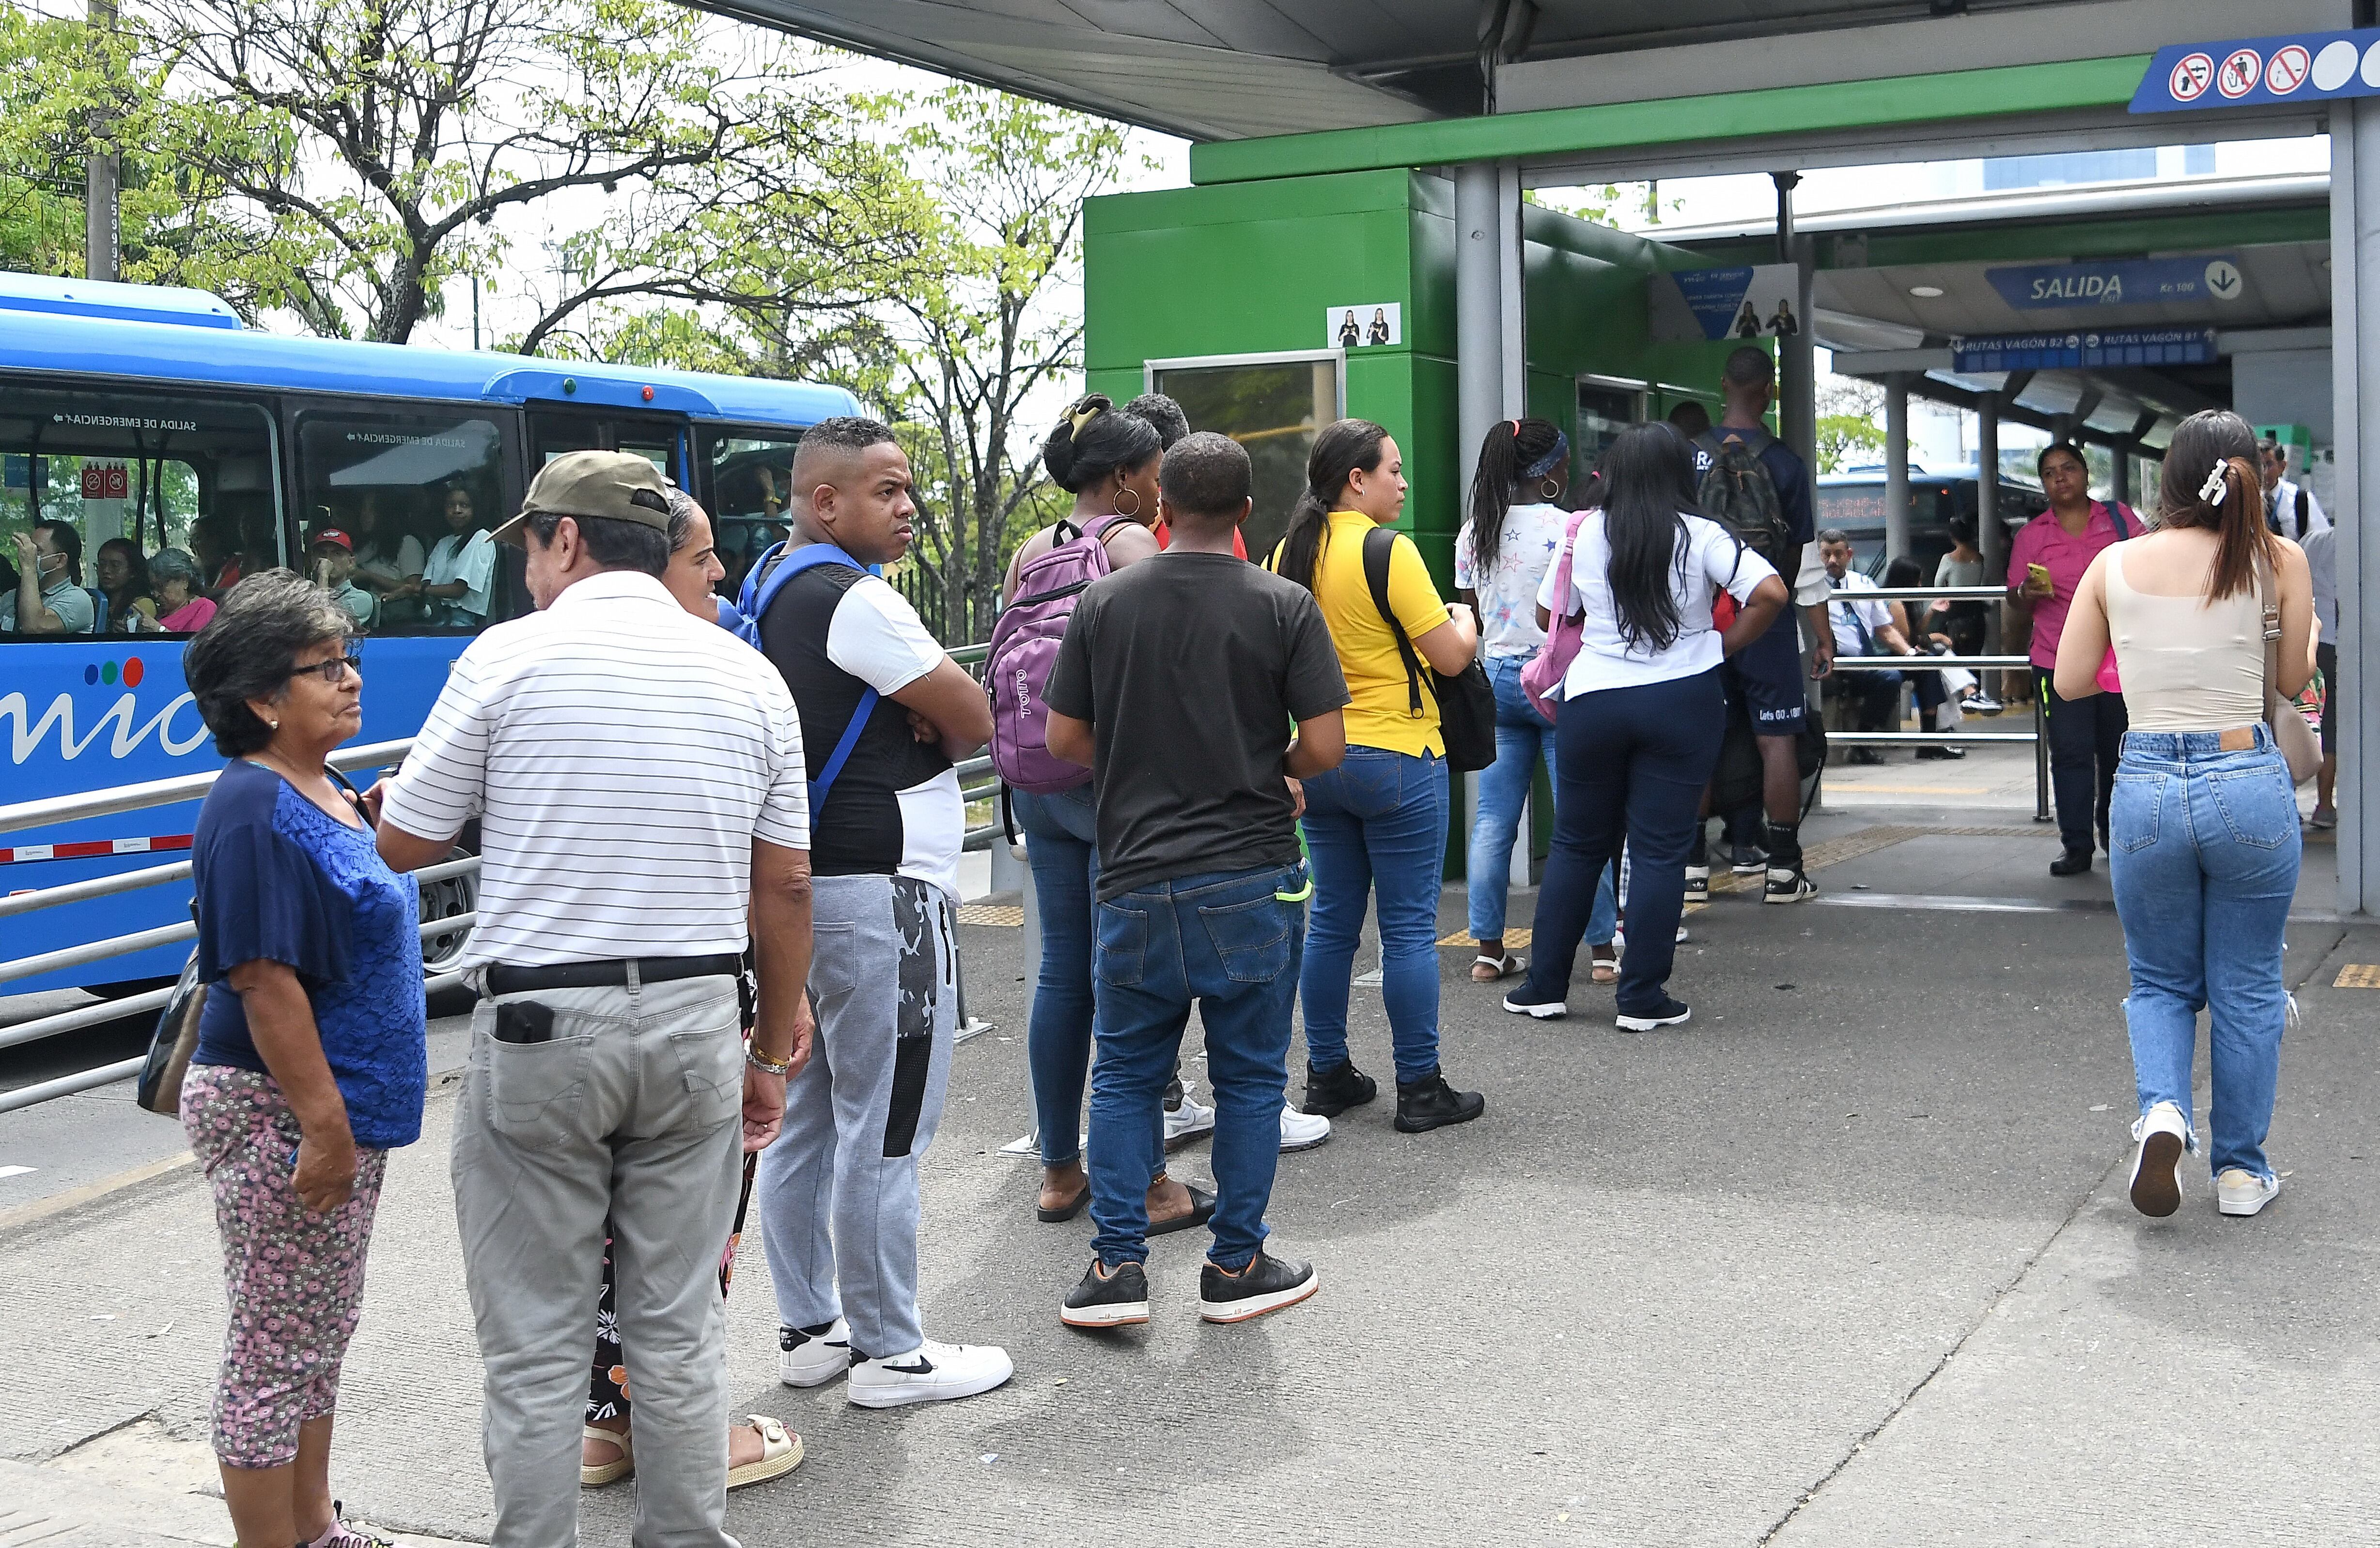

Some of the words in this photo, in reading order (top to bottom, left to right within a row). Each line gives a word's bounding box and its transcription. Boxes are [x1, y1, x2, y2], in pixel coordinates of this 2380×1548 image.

[2030, 275, 2122, 299] SALIDA
[1966, 340, 2002, 351] RUTAS
[2103, 334, 2139, 344] RUTAS
[1015, 669, 1031, 719] TOTTO
